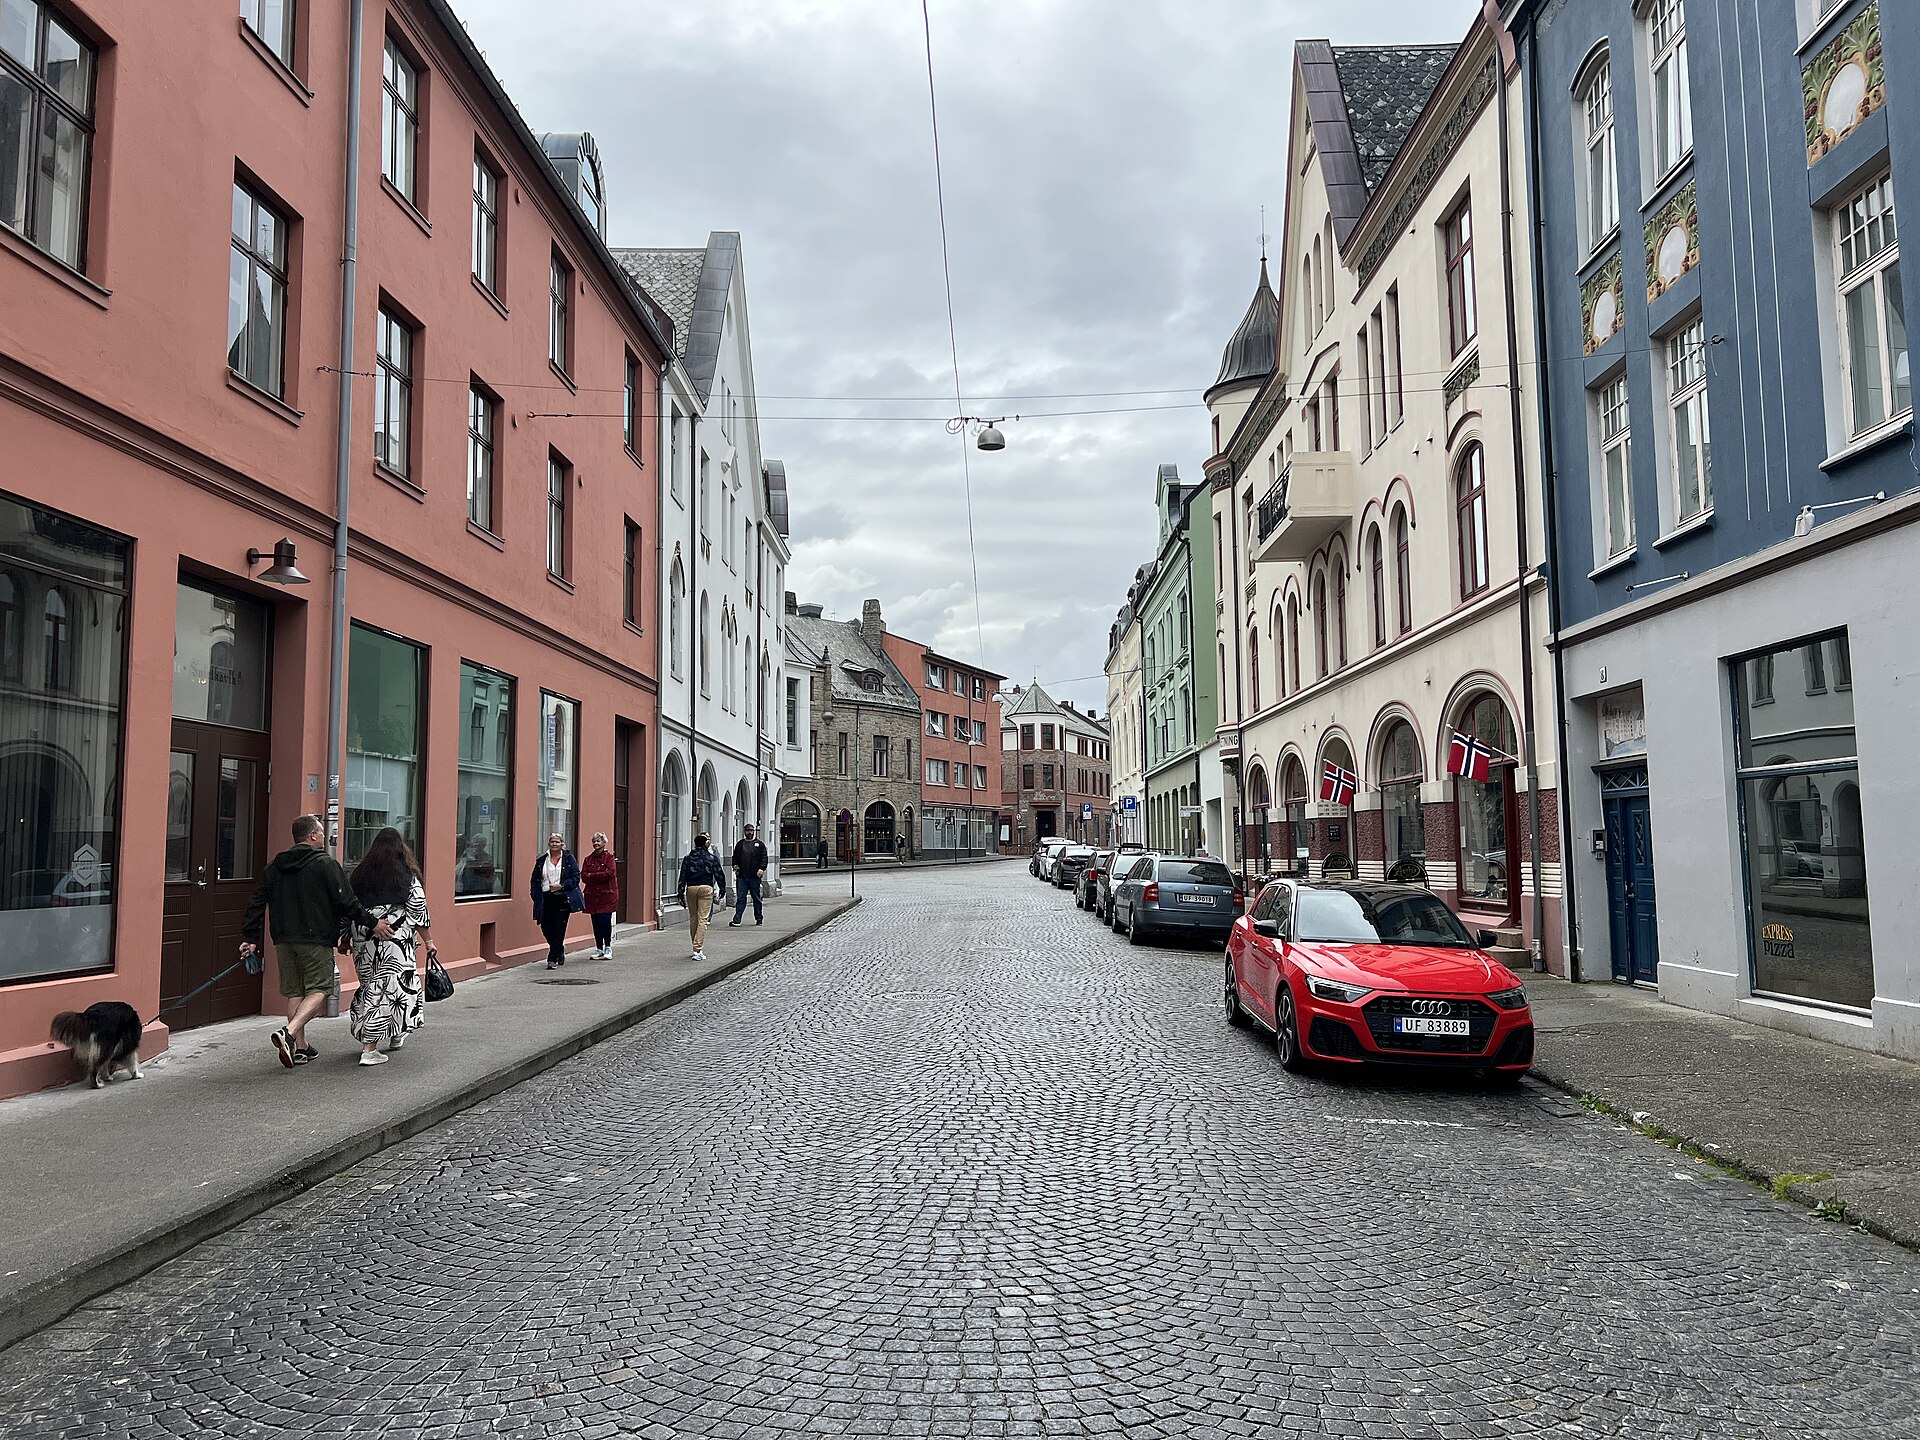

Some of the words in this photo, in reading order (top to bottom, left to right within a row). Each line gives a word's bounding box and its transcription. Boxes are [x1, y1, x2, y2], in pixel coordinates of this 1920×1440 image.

[1126, 799, 1132, 808] P
[1762, 923, 1794, 942] EXPRESS
[1405, 1019, 1421, 1031] UF
[1427, 1020, 1466, 1033] 83889
